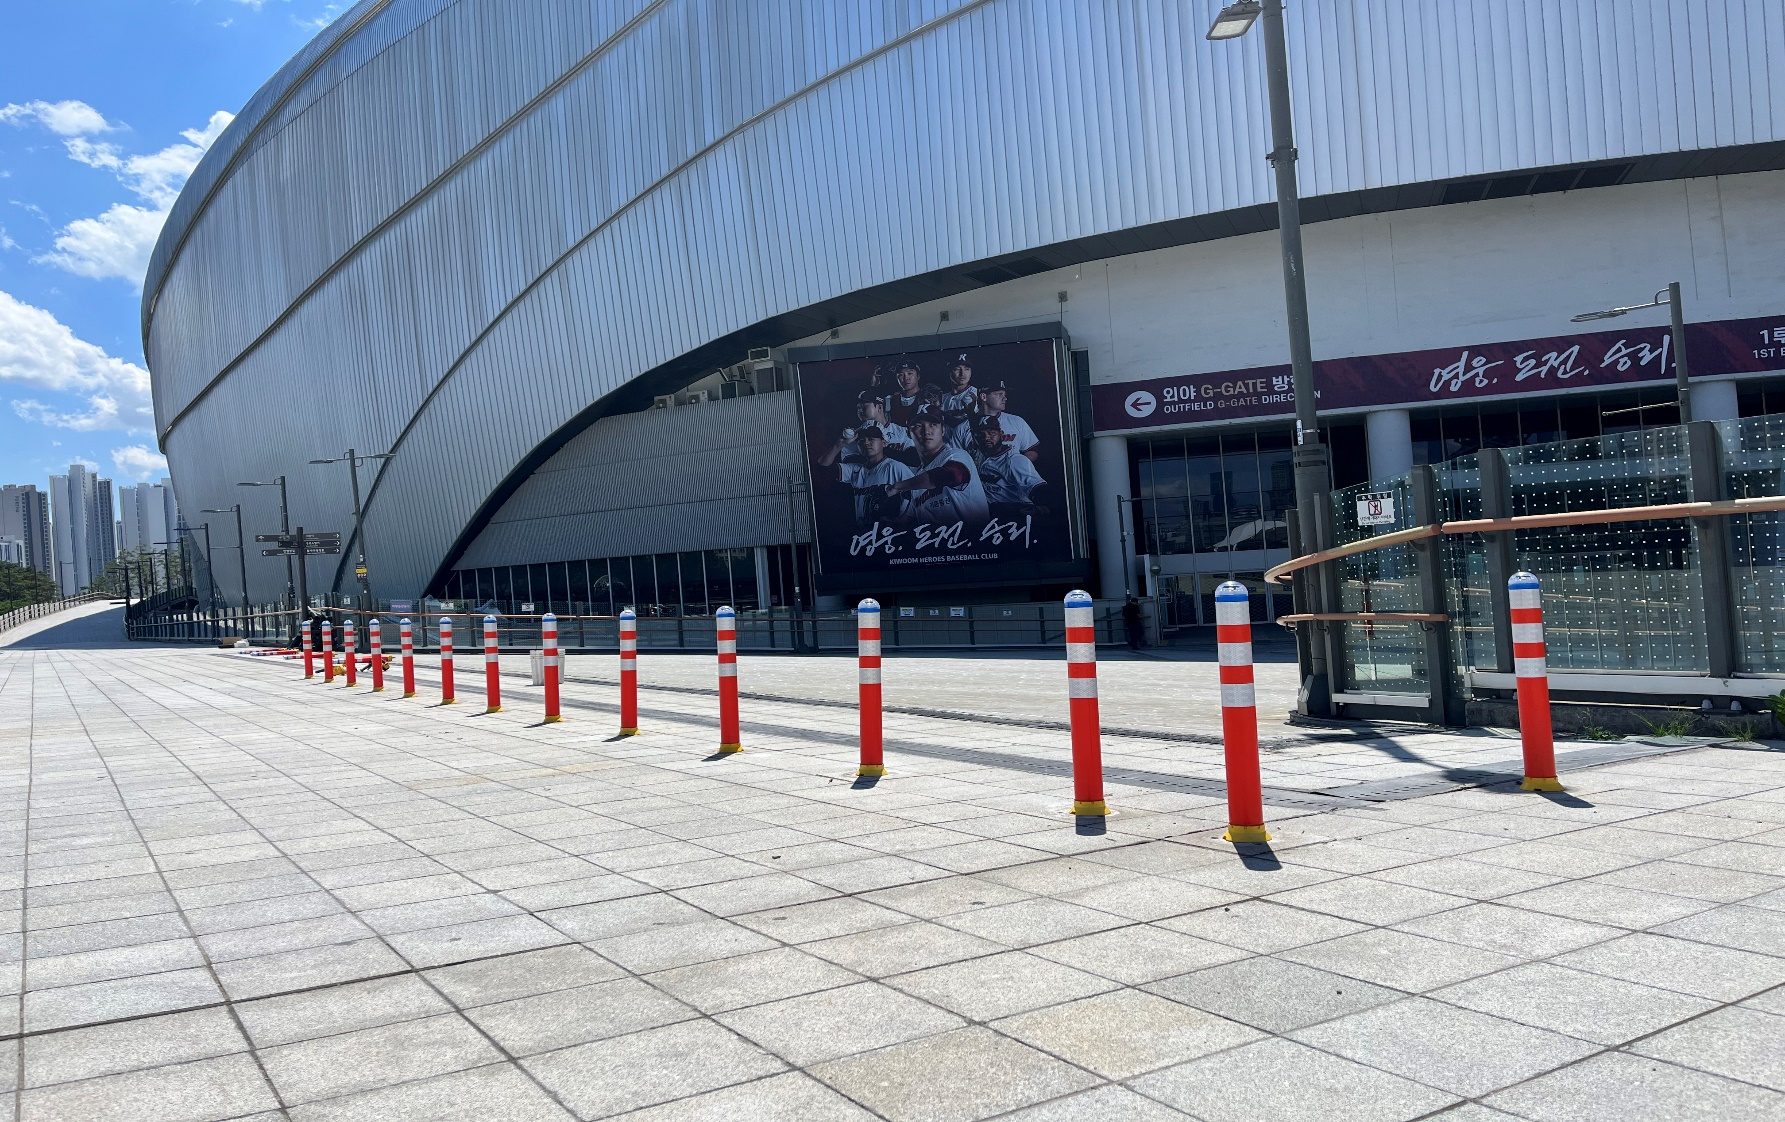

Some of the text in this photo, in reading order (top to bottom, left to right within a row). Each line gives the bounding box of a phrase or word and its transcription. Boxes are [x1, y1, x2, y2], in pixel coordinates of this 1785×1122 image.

[1429, 334, 1677, 393] 영웅. 도전. 승리.
[1753, 348, 1776, 359] 1ST
[1163, 385, 1196, 402] 외야
[1201, 379, 1266, 397] G-GATE
[1163, 390, 1321, 414] OUTFIELD G-GATE DIRECN
[850, 514, 1038, 556] 영웅. 도전. 승리.
[920, 555, 945, 563] HEROES
[946, 553, 980, 562] BASEBALL
